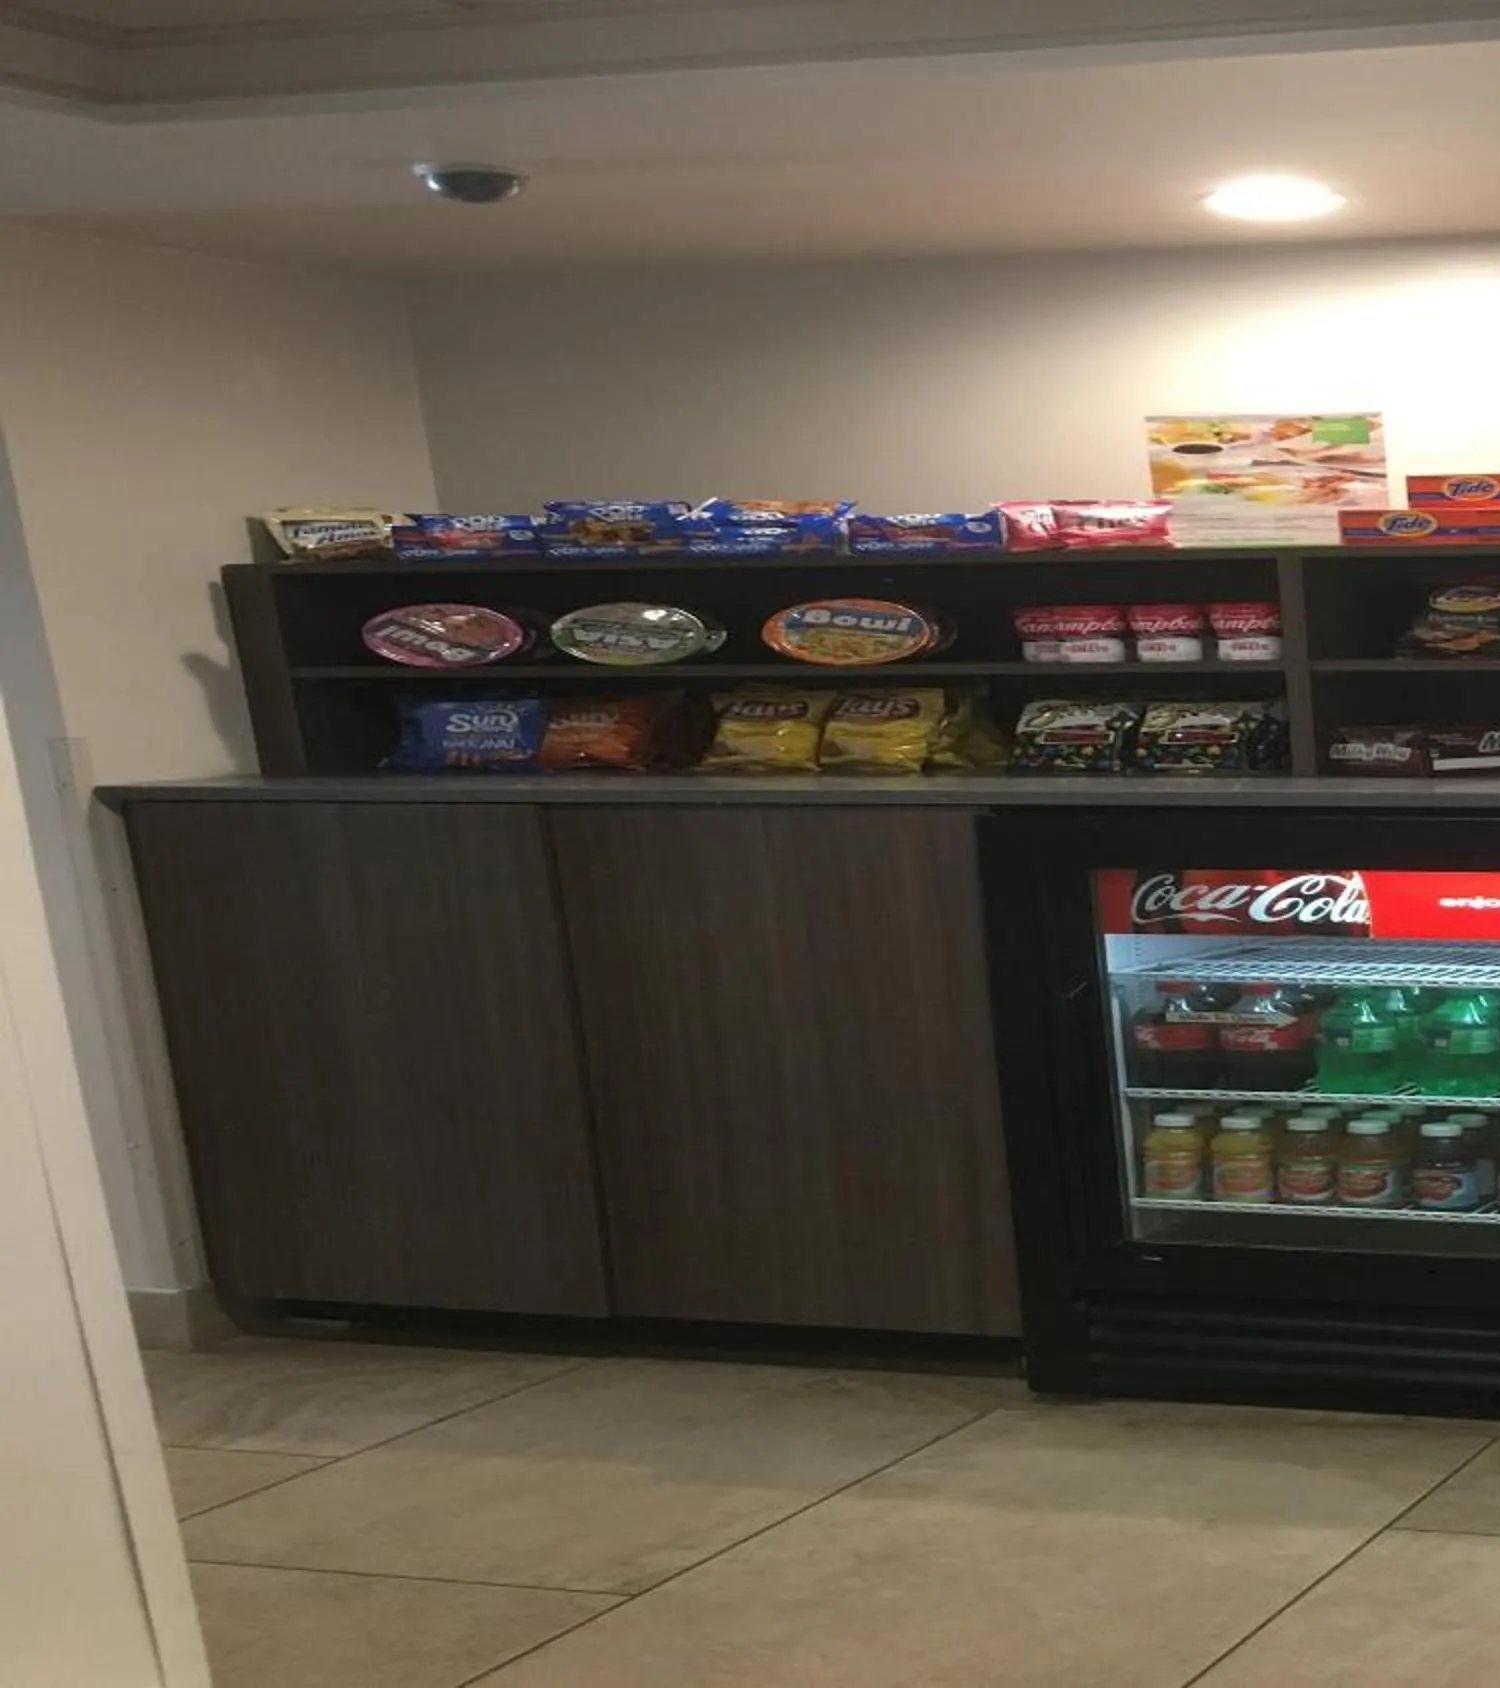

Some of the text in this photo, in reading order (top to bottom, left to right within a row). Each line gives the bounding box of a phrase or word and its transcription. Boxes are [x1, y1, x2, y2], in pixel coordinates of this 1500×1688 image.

[1449, 479, 1494, 496] Tide
[1387, 516, 1432, 533] Tide
[802, 609, 913, 632] Bowl
[1131, 872, 1371, 923] Coca-Cola
